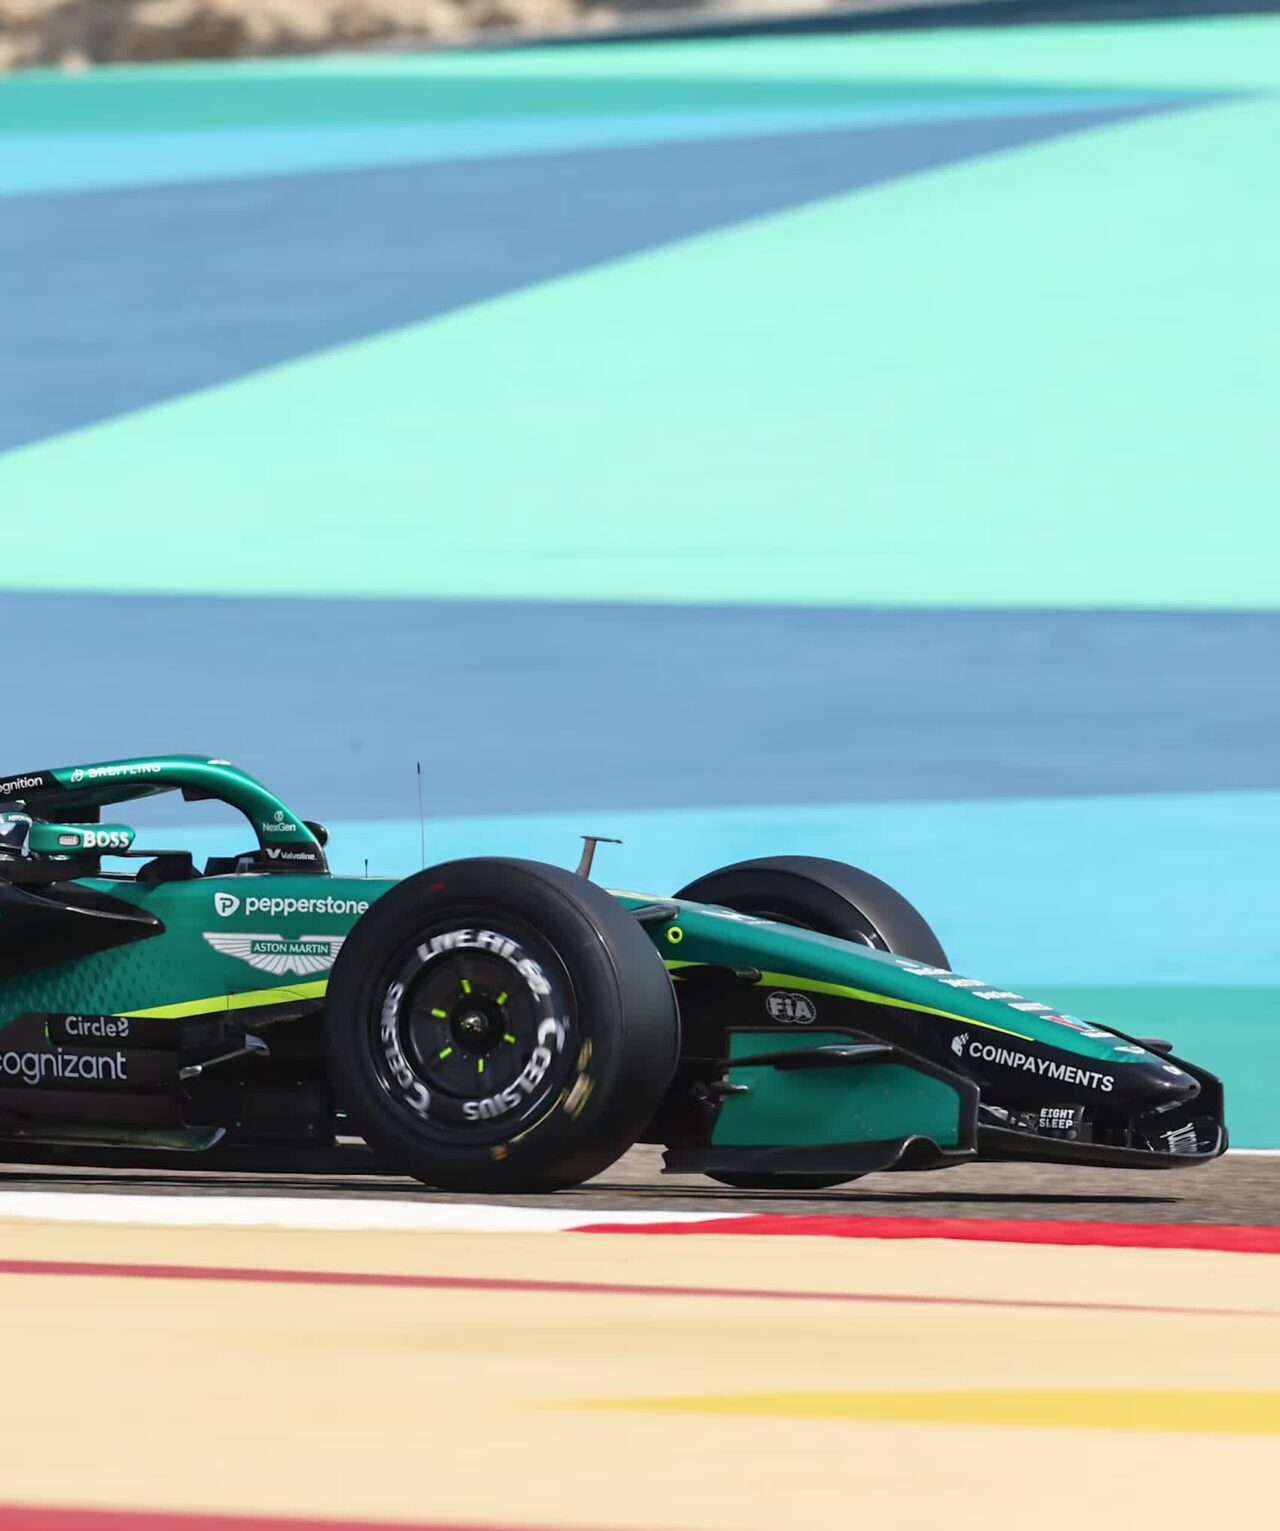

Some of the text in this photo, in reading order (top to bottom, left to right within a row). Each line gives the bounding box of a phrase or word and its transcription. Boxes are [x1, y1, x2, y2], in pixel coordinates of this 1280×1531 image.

[88, 763, 161, 778] BREITLING
[262, 822, 296, 832] NexGen
[83, 830, 129, 848] BOSS
[281, 851, 315, 860] Valvoline
[245, 896, 369, 917] pepperstone
[253, 943, 329, 954] ASTON MARTIN
[970, 1041, 1115, 1092] COINPAYMENTS
[1040, 1107, 1075, 1119] EIGHT
[1039, 1118, 1074, 1130] SLEEP
